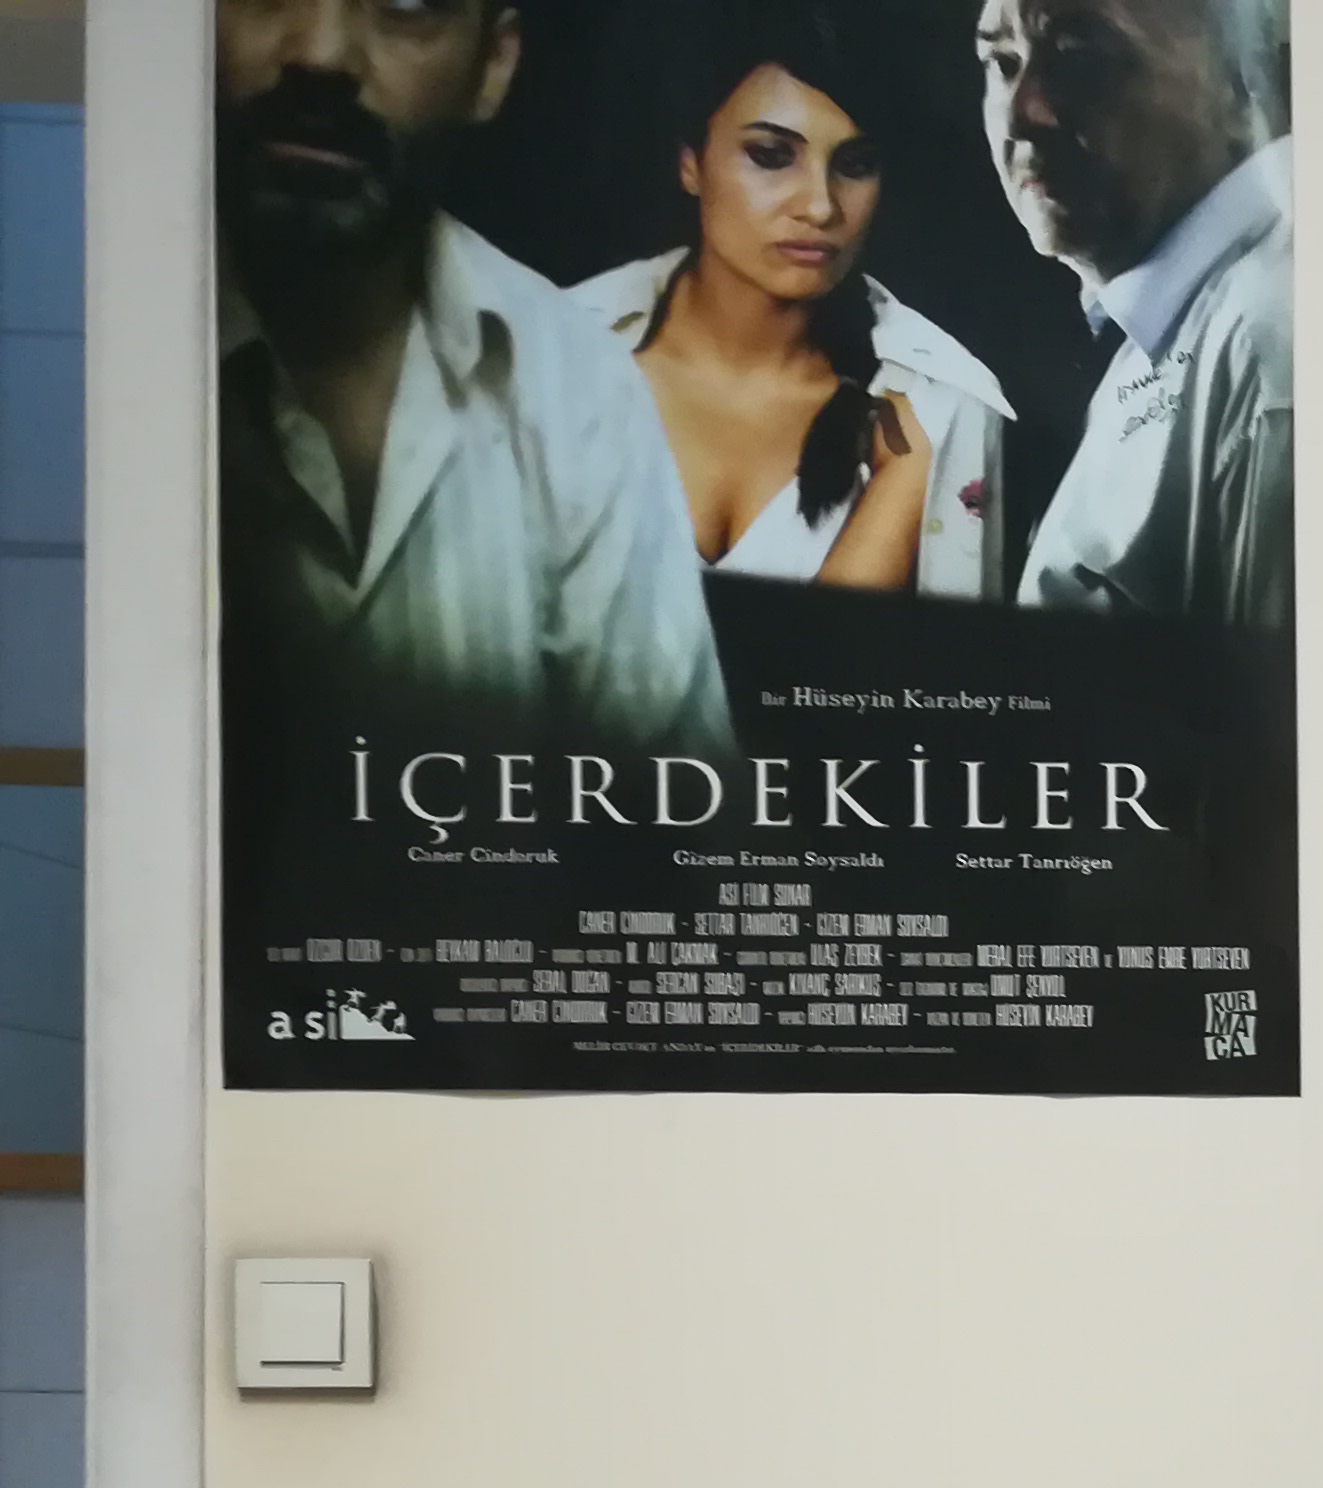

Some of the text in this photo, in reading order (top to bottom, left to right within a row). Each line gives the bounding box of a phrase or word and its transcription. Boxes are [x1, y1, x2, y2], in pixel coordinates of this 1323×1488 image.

[793, 686, 895, 714] Hüseyin
[902, 688, 1002, 716] Karabey
[1008, 694, 1051, 712] Filmi
[349, 735, 1171, 844] İÇERDEKİLER
[407, 846, 465, 863] Caner
[672, 849, 885, 872] Gizem Erman Soysaldı
[955, 853, 1114, 875] Settar Tanrıöğen
[1210, 992, 1251, 1012] KUR
